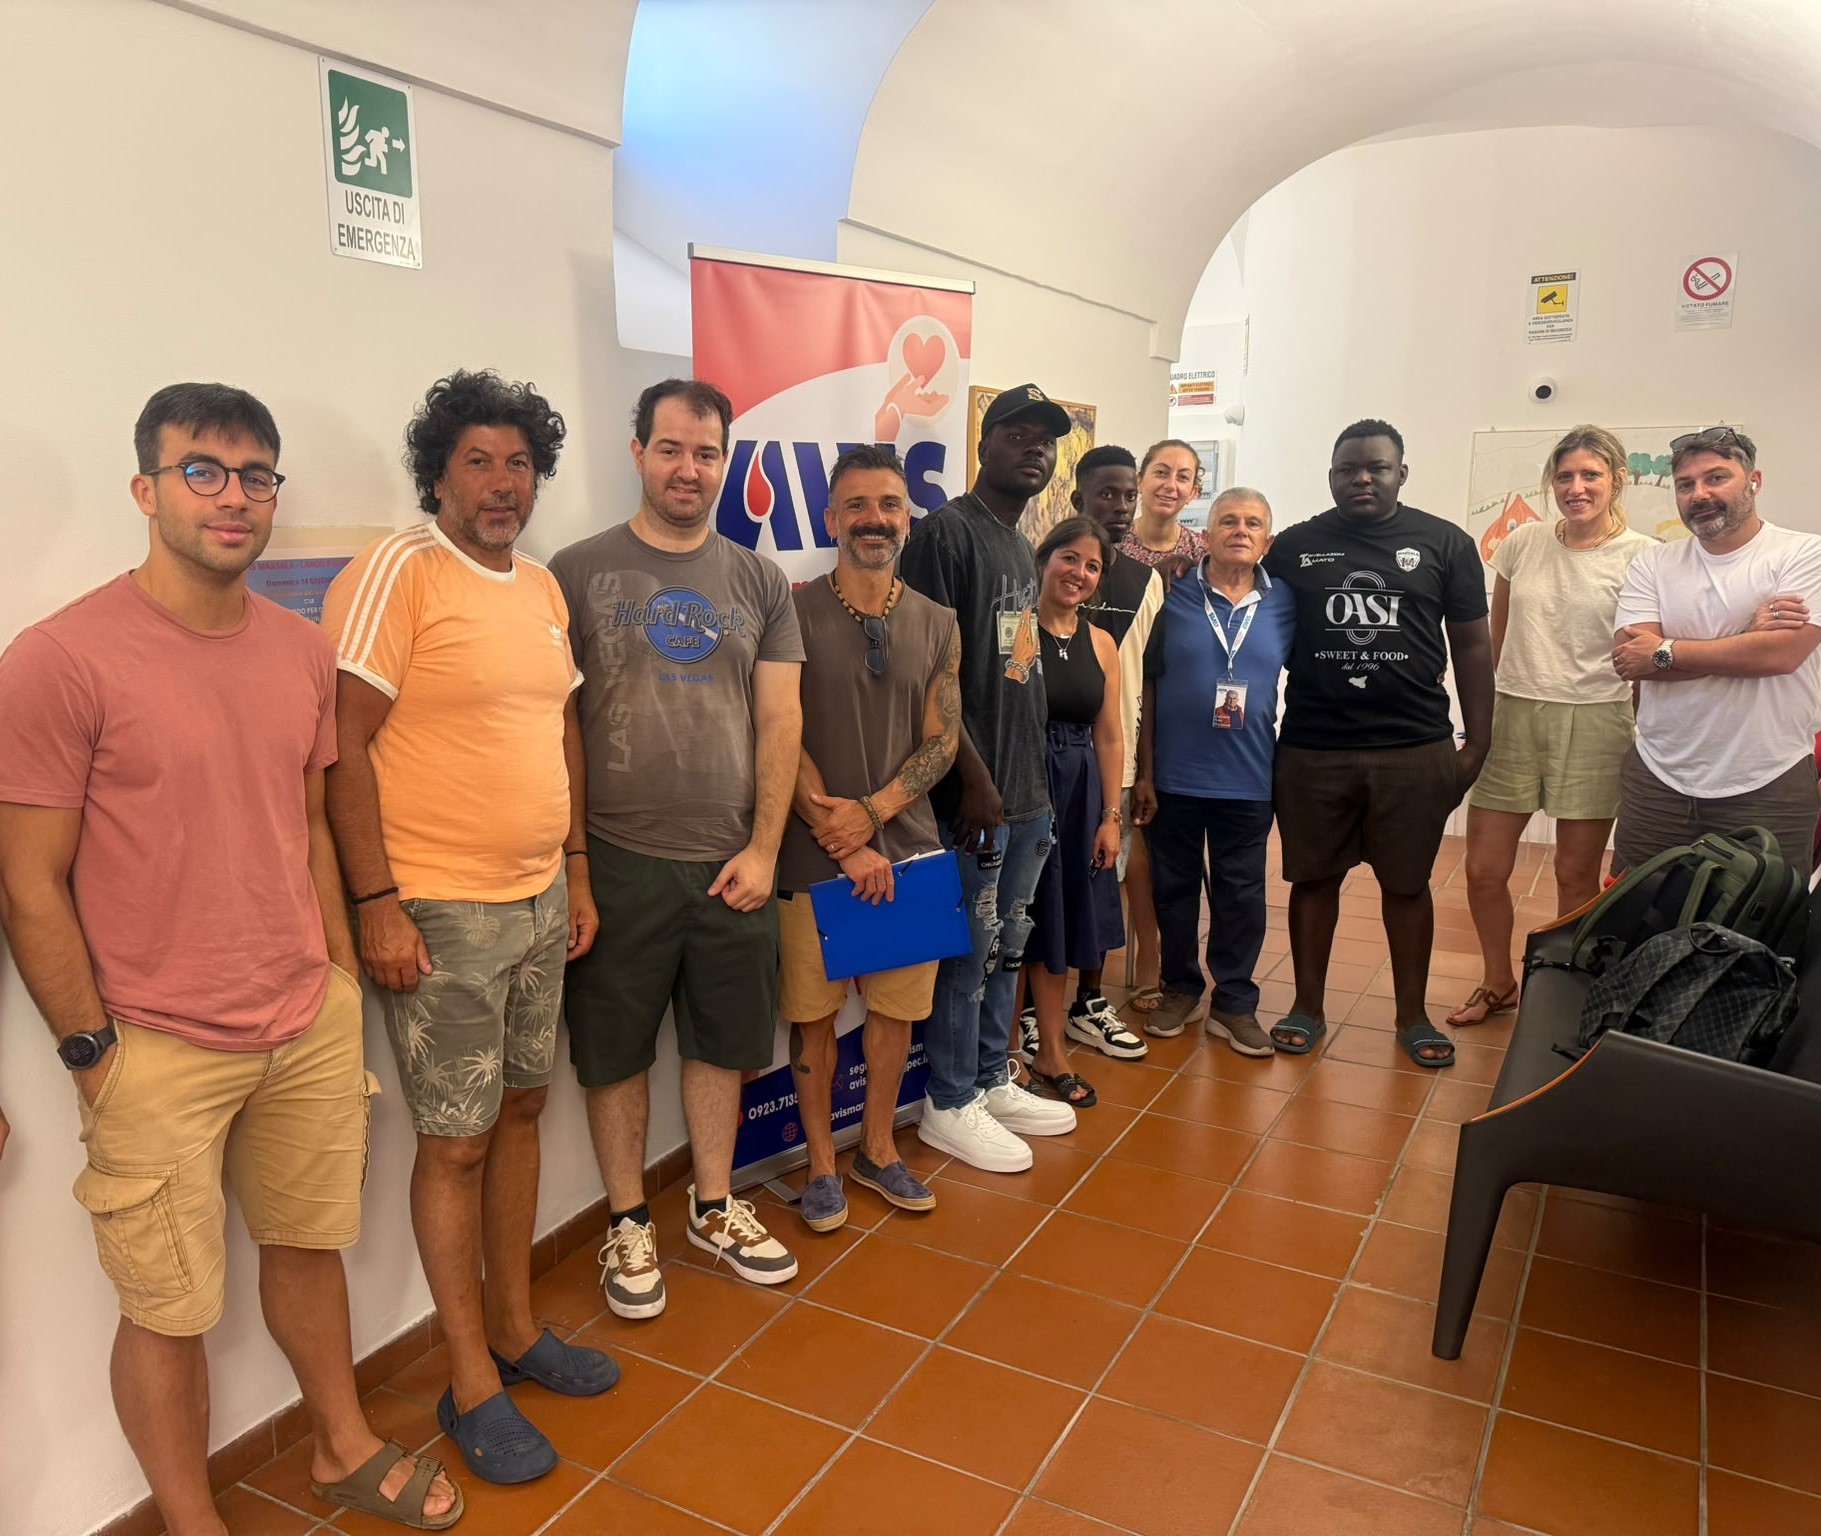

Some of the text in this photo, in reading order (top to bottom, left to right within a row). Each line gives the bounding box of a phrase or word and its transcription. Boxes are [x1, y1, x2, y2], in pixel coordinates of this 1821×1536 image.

[345, 190, 405, 225] USCITA DI
[337, 223, 416, 261] EMERGENZA
[1188, 371, 1215, 379] ELETTRICO
[716, 440, 948, 551] AVS
[611, 599, 747, 638] Hard Rock
[1325, 592, 1404, 627] OASI
[665, 634, 701, 648] CAFE
[1341, 662, 1380, 671] dal 1996
[1360, 651, 1369, 660] &
[659, 673, 714, 683] LAS VEGAS
[606, 703, 633, 773] LAS
[849, 1075, 867, 1090] avis
